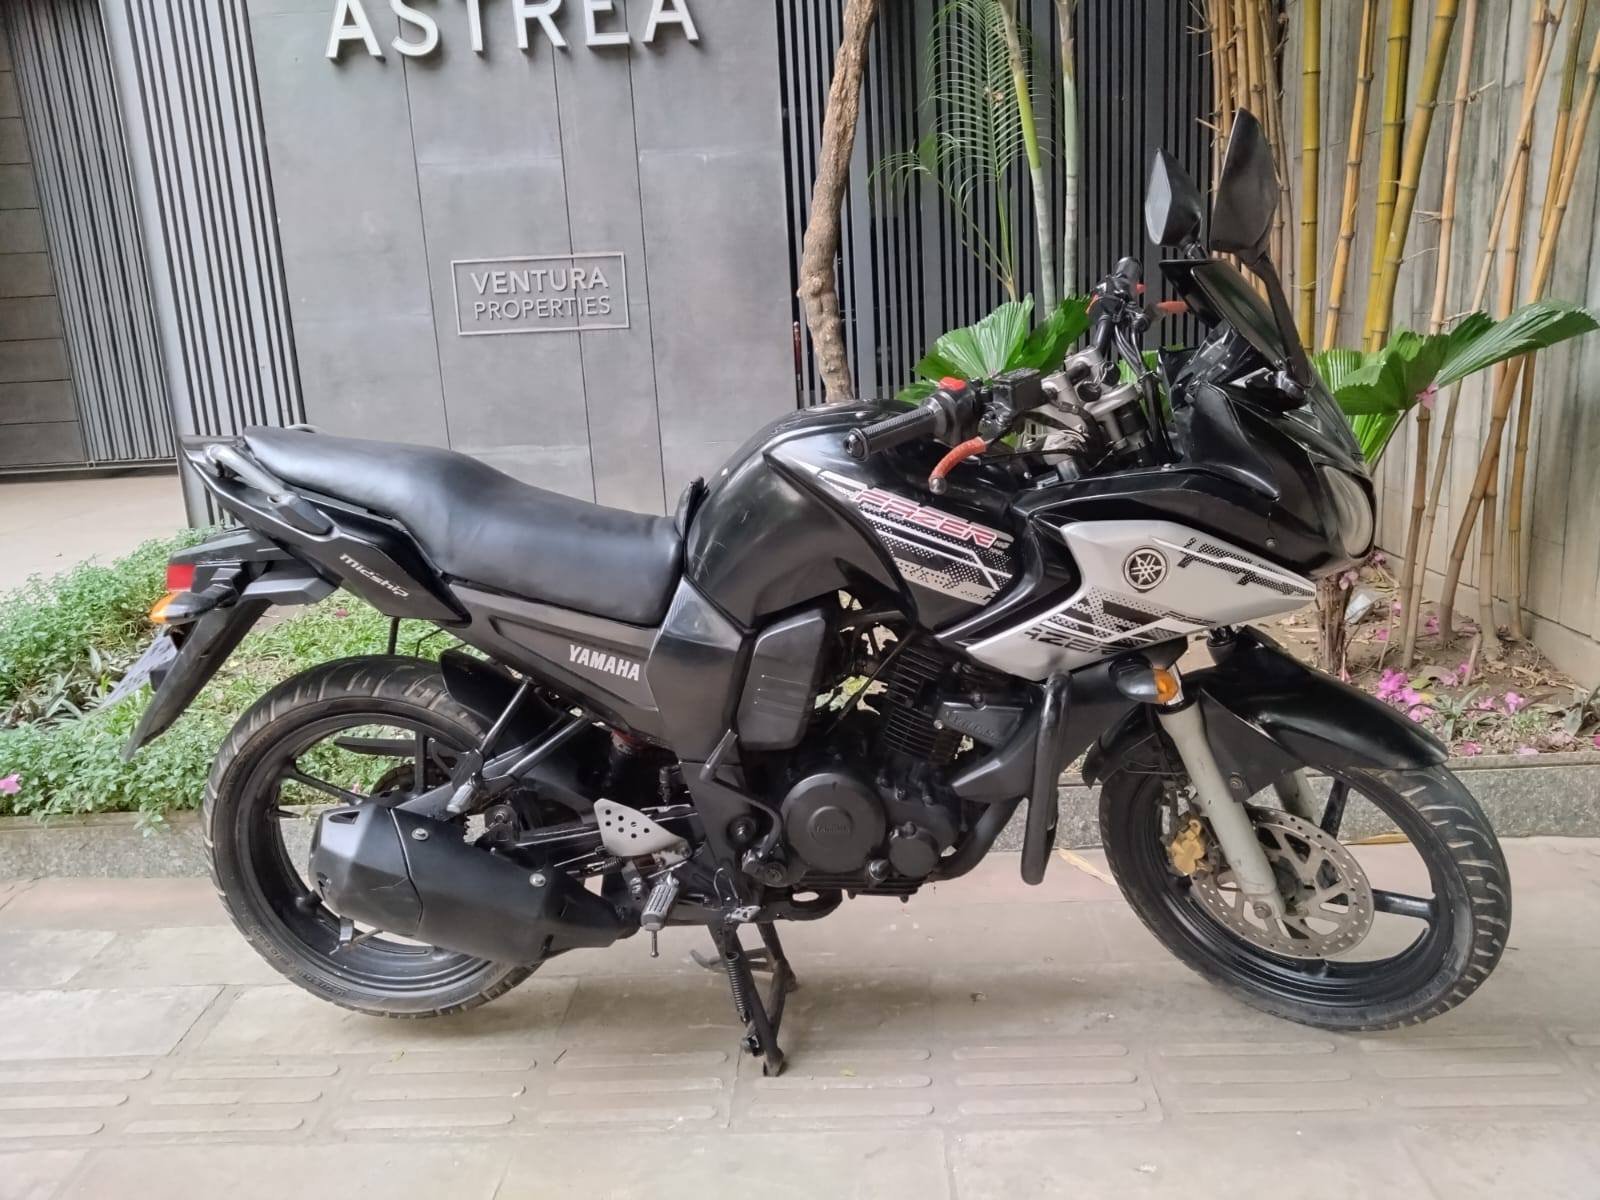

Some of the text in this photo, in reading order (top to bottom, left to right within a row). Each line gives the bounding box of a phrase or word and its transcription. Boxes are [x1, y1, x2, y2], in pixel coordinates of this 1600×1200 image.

[470, 266, 609, 295] VENTURA
[474, 295, 611, 320] PROPERTIES
[855, 488, 998, 549] FAZER
[569, 644, 640, 682] YAMAHA
